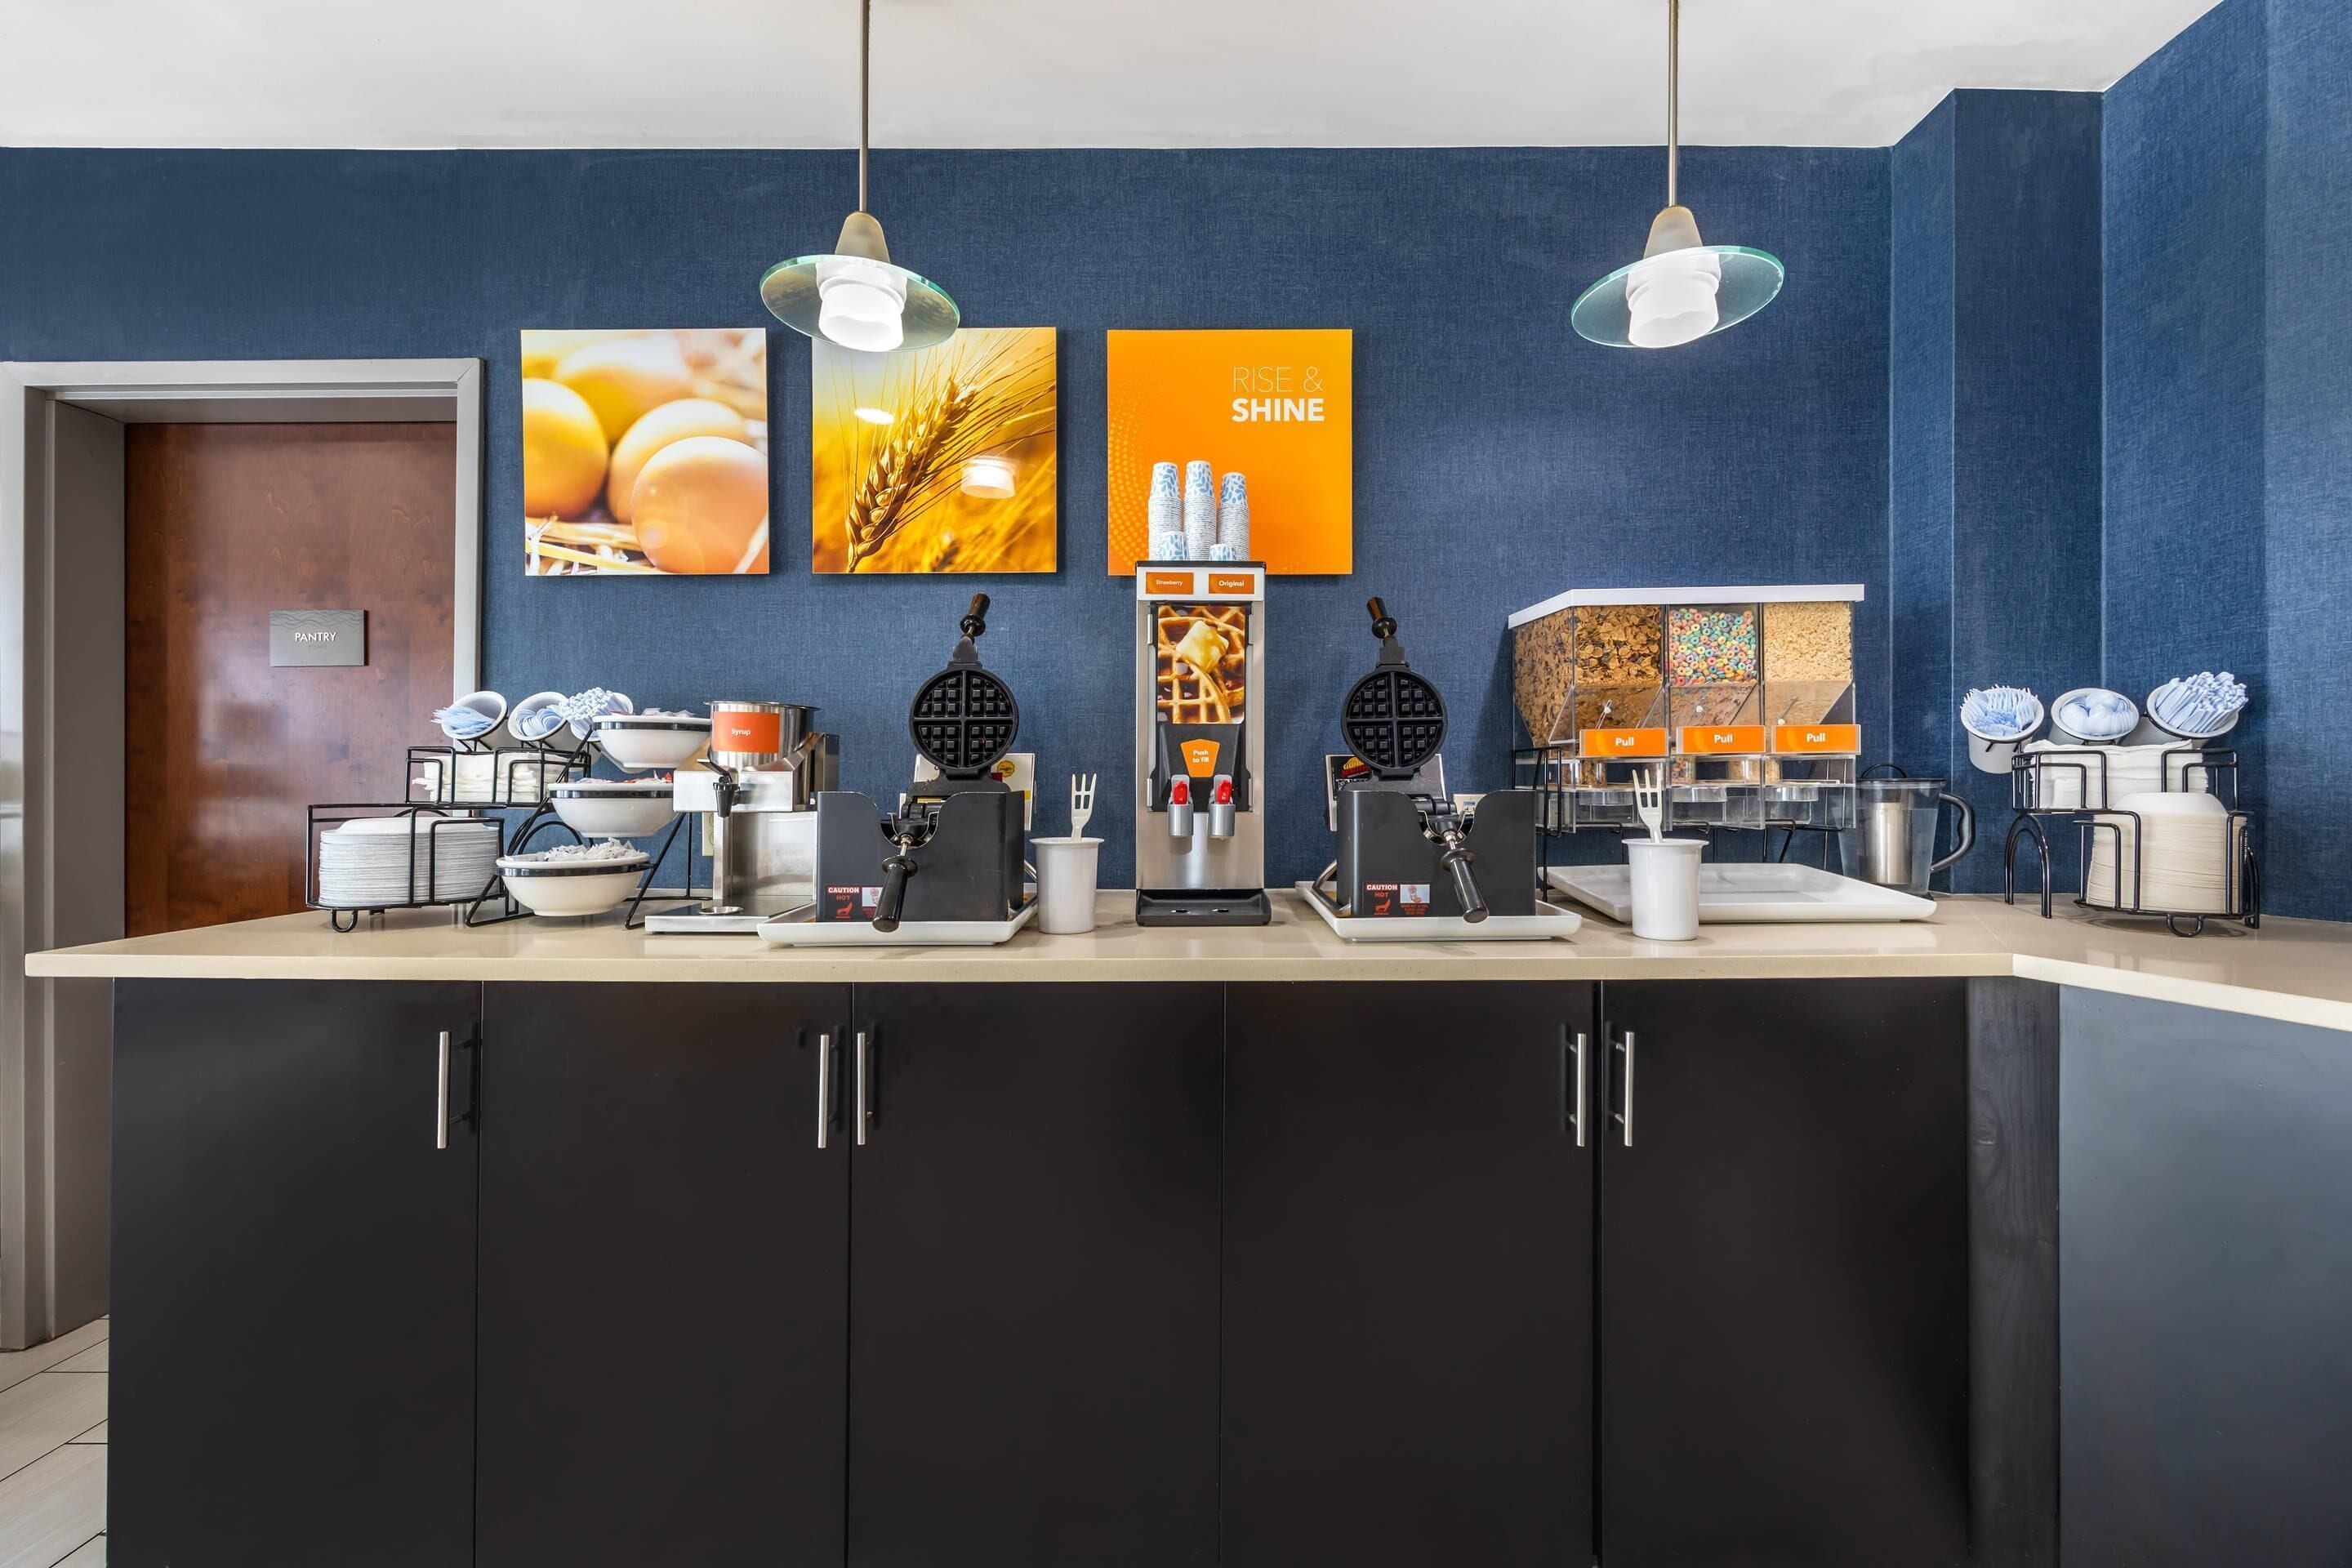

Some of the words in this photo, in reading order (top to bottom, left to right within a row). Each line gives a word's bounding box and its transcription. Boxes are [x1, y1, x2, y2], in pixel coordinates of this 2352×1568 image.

[1233, 366, 1293, 392] RISE
[1303, 366, 1324, 392] &
[1232, 398, 1325, 422] SHINE
[295, 632, 337, 642] PANTRY
[731, 728, 751, 736] Syrup
[1615, 737, 1634, 746] Pull
[1714, 734, 1733, 743] Pull
[1806, 733, 1825, 742] Pull
